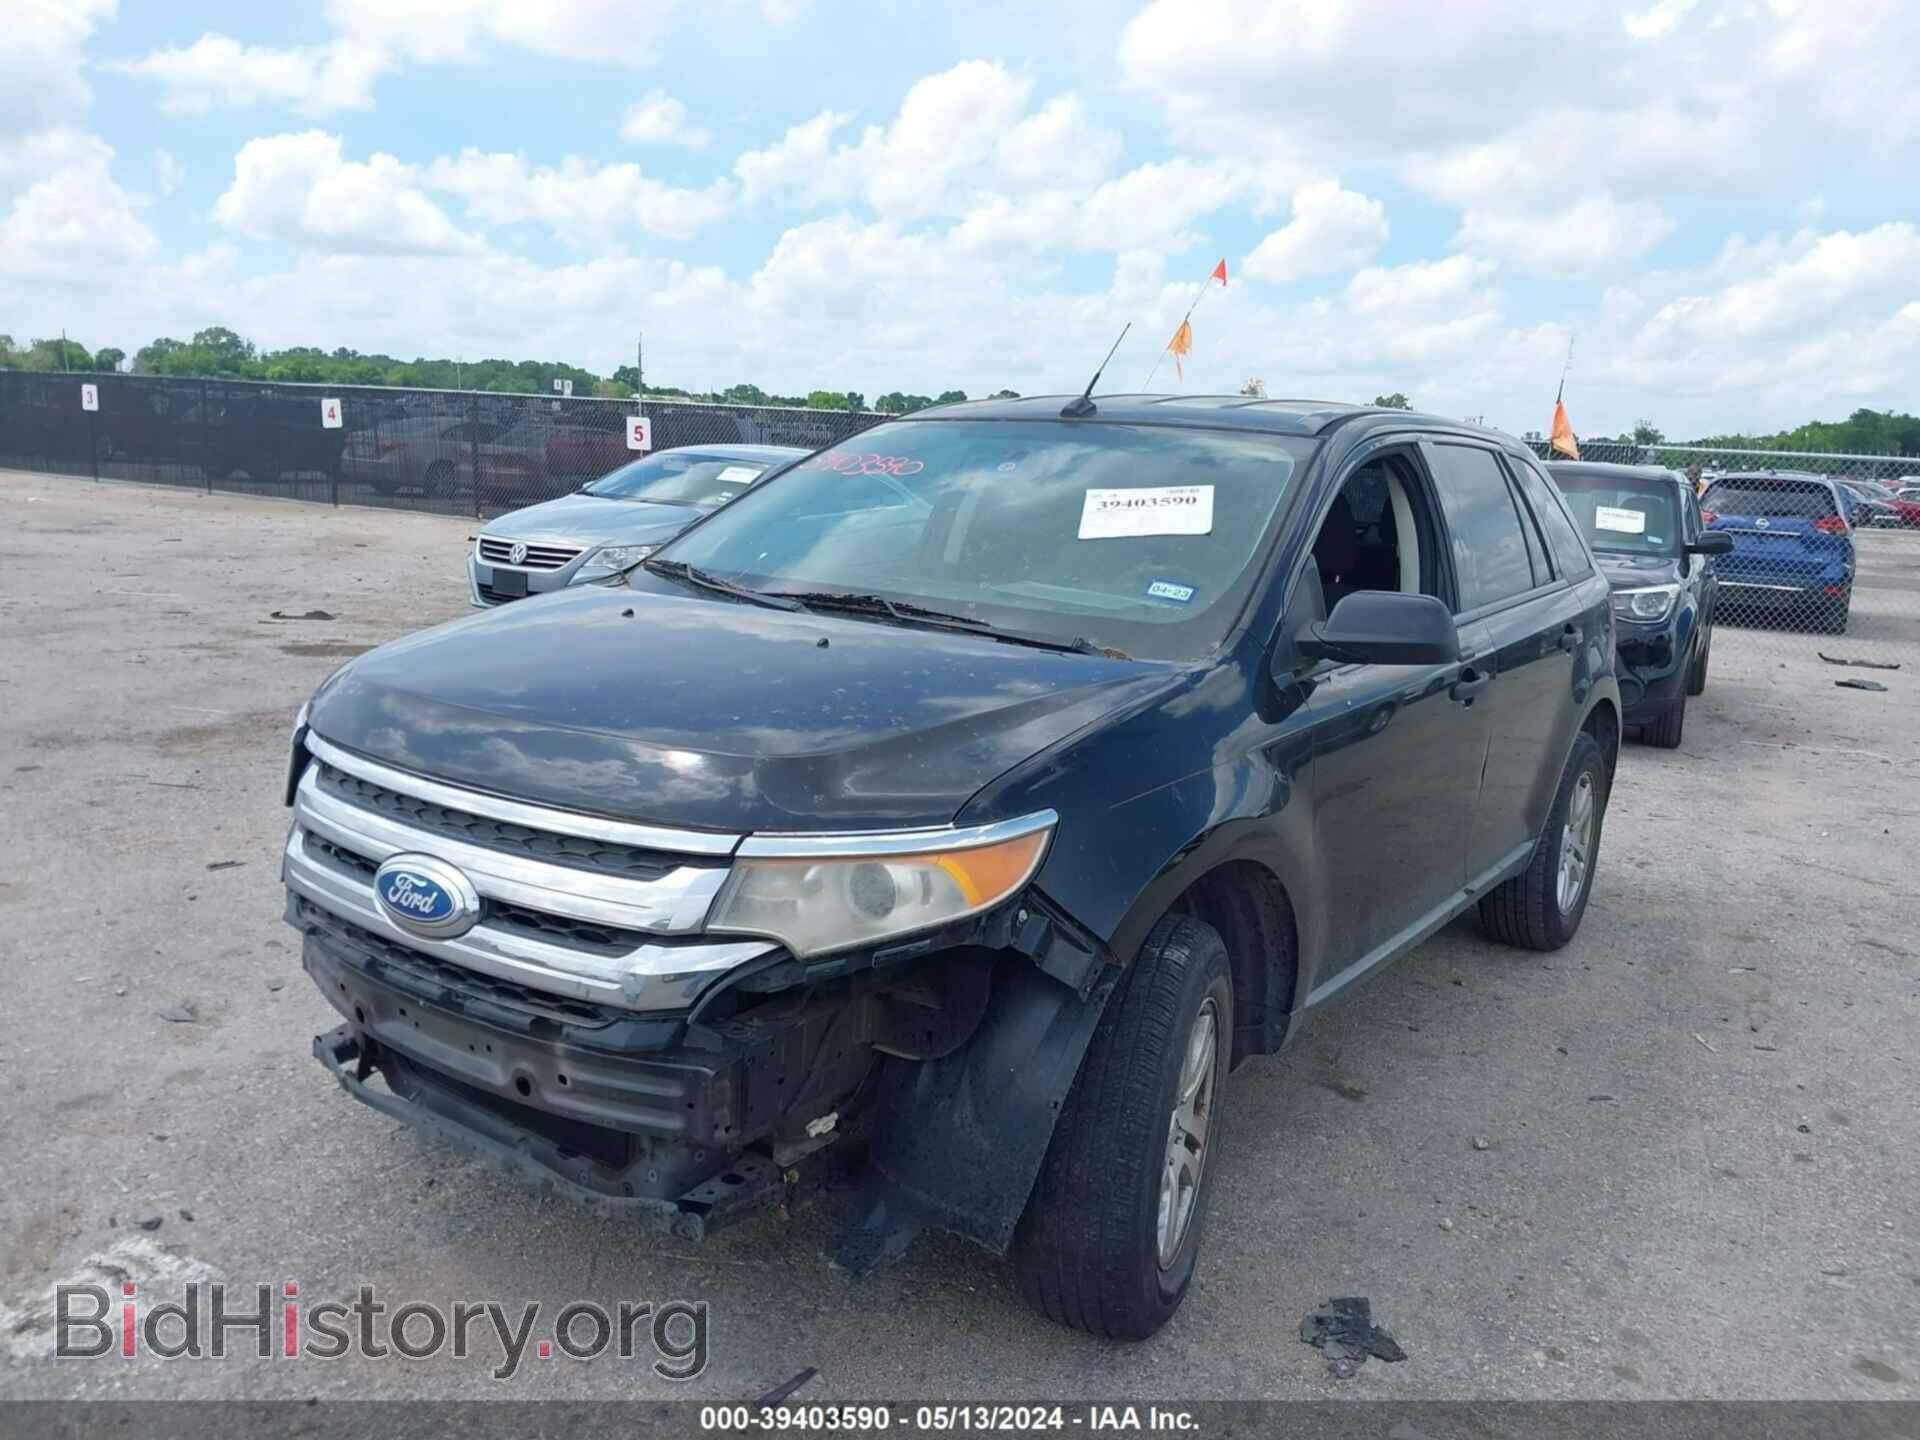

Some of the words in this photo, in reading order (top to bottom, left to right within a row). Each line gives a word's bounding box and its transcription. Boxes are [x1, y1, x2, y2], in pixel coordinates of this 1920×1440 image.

[327, 406, 337, 421] 4
[633, 424, 645, 442] 5
[1099, 496, 1198, 509] 39403590
[387, 872, 438, 914] Ford
